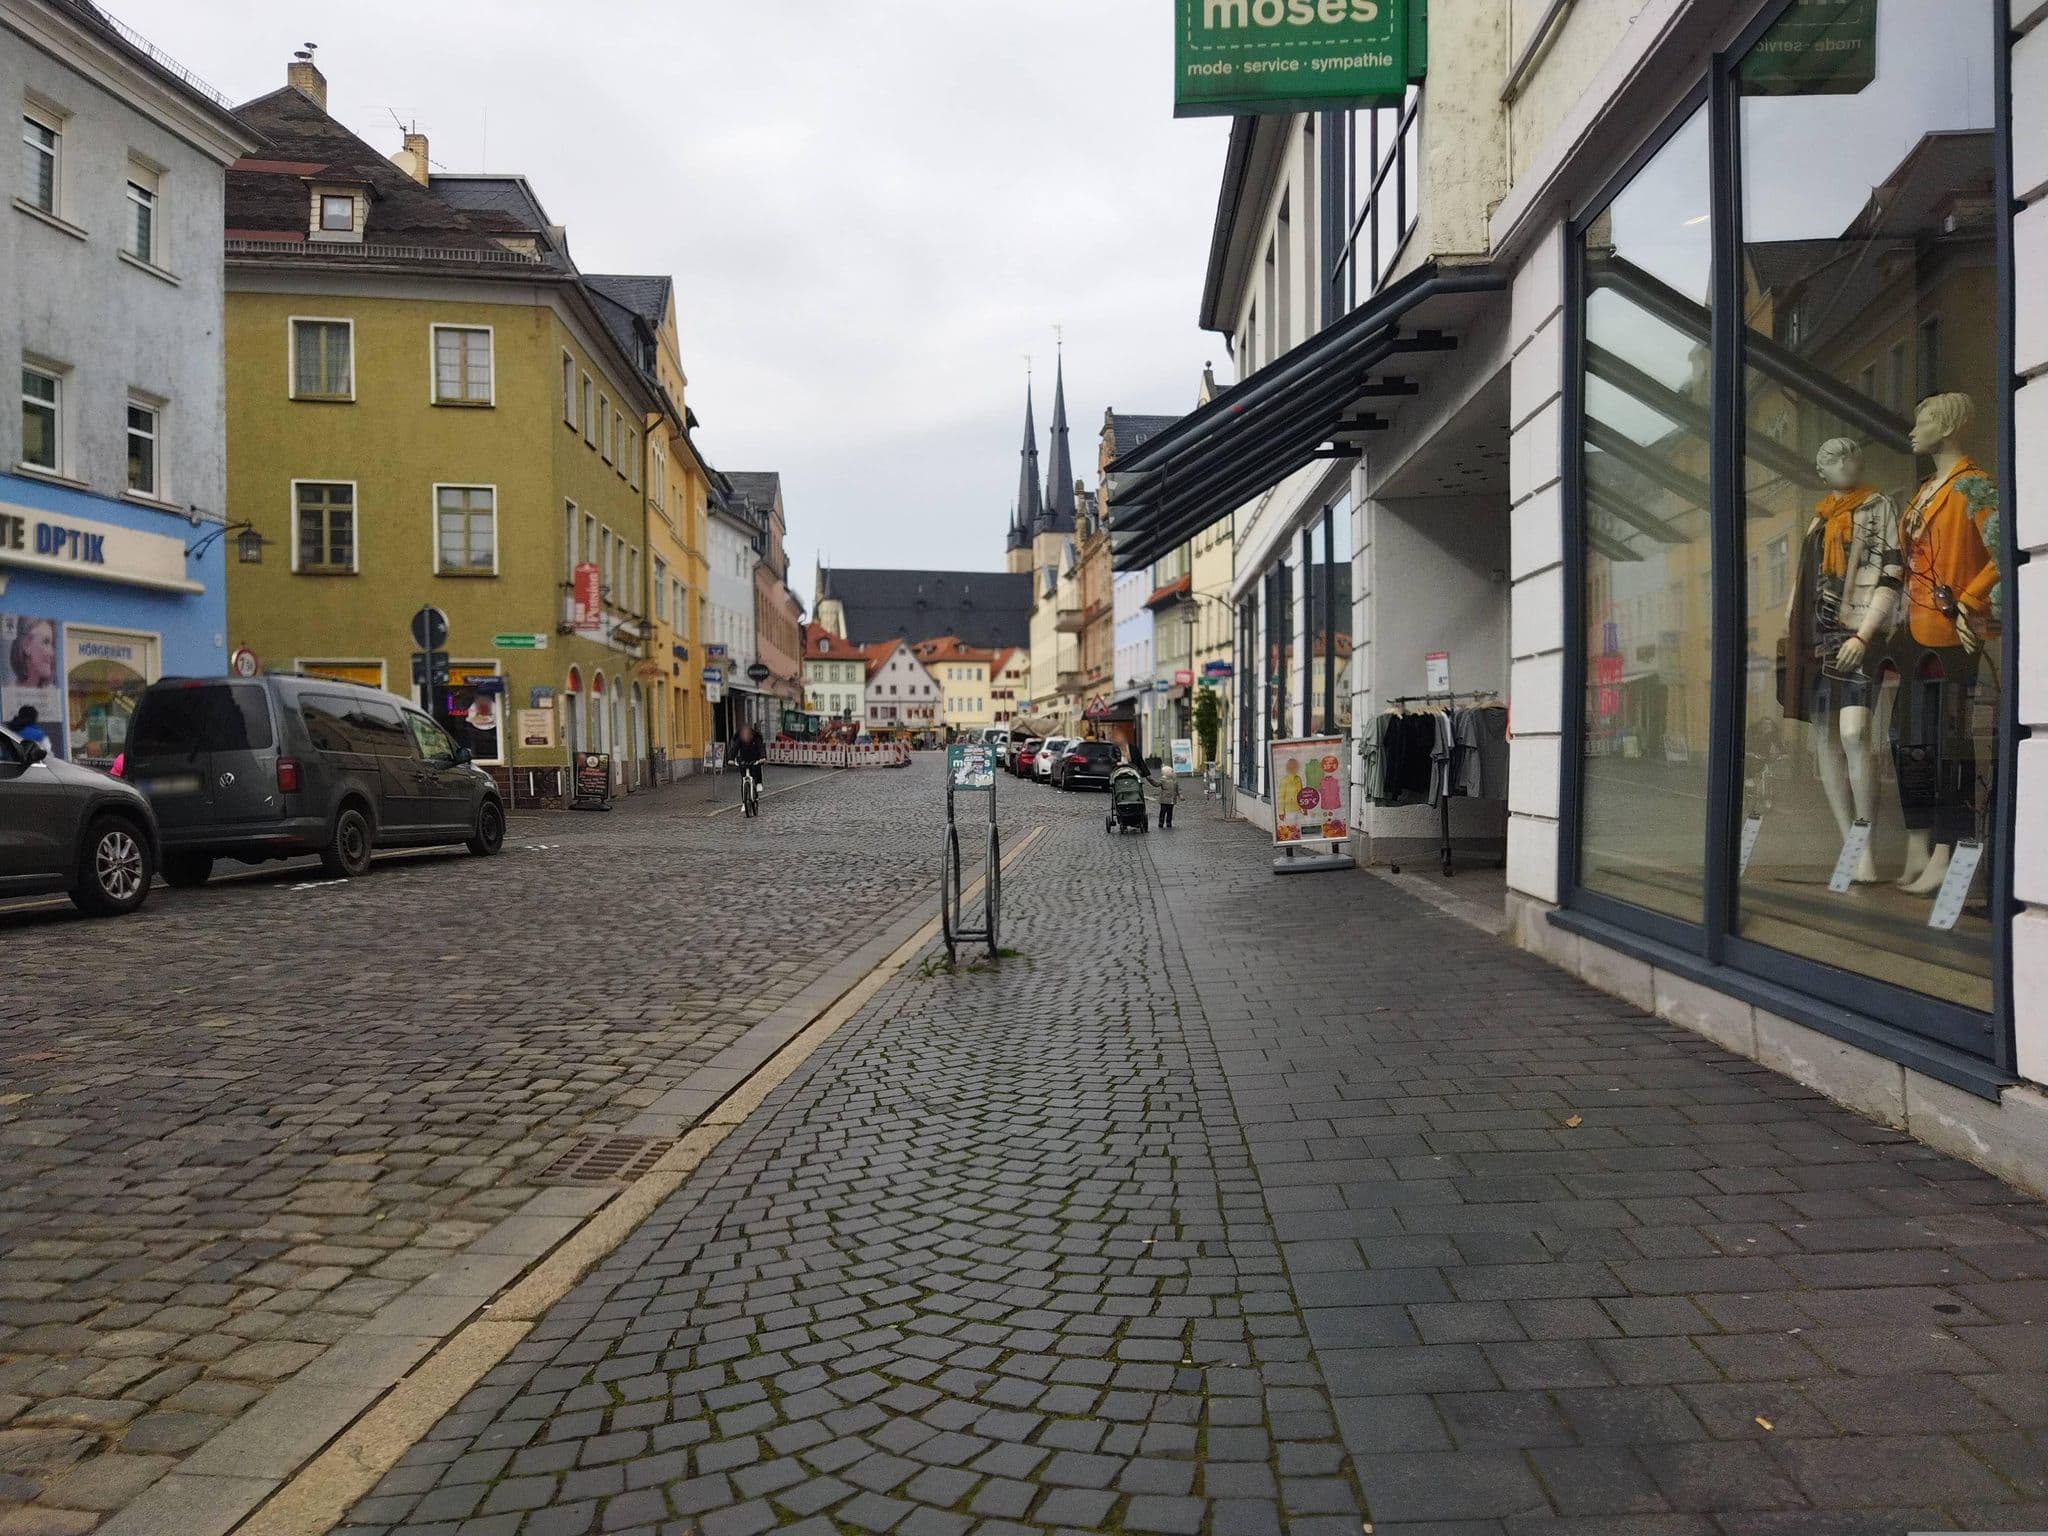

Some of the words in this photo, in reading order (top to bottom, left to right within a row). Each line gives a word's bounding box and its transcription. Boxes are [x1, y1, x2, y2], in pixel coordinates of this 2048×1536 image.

[1204, 0, 1378, 29] moses
[1187, 60, 1233, 76] mode
[1243, 57, 1300, 74] service
[1311, 52, 1393, 73] sympathie
[36, 522, 105, 564] OPTIK
[586, 572, 599, 622] Pension
